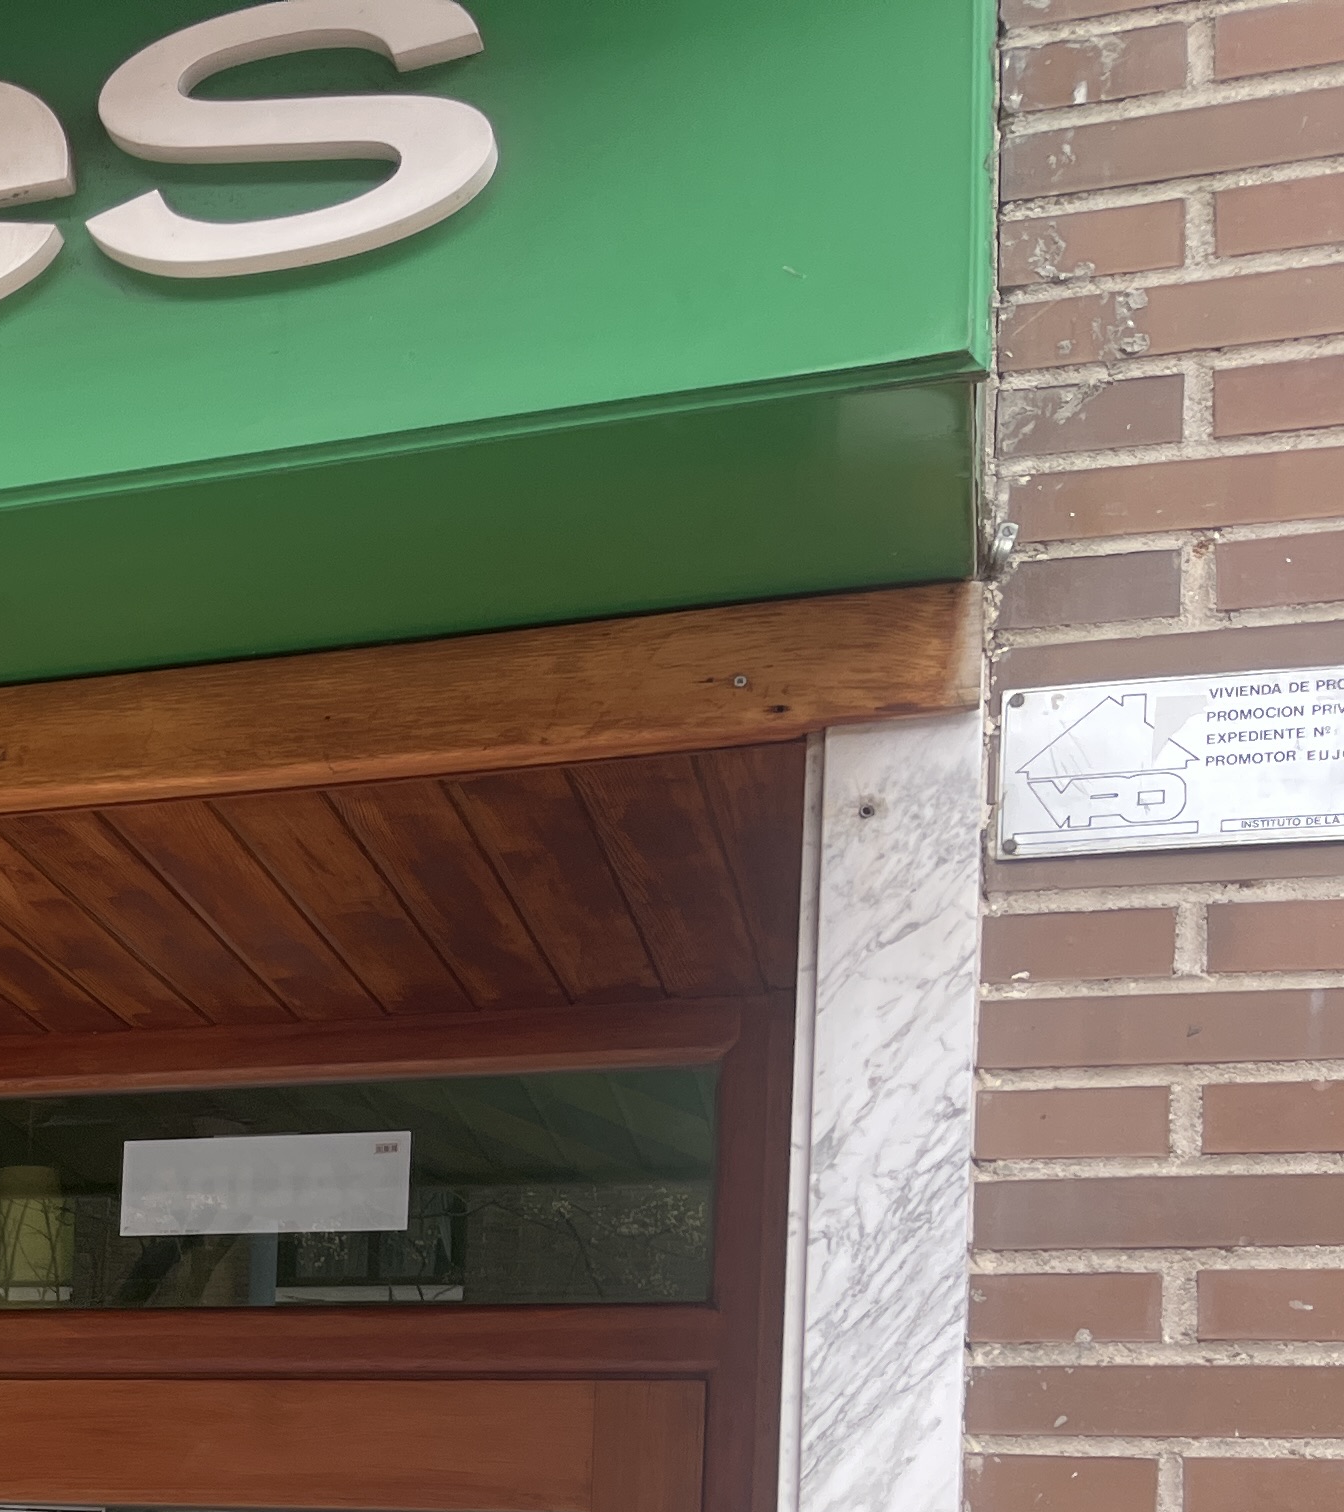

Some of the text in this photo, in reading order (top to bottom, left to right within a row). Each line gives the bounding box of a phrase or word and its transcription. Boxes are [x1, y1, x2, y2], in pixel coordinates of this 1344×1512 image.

[1209, 683, 1282, 699] VIVIENDA
[1288, 681, 1310, 693] DE
[1206, 705, 1305, 723] PROMOCION
[1206, 727, 1306, 745] EXPEDIENTE
[1205, 749, 1344, 767] PROMOTOR EUJ
[1241, 814, 1340, 829] INSTITUTO DE LA
